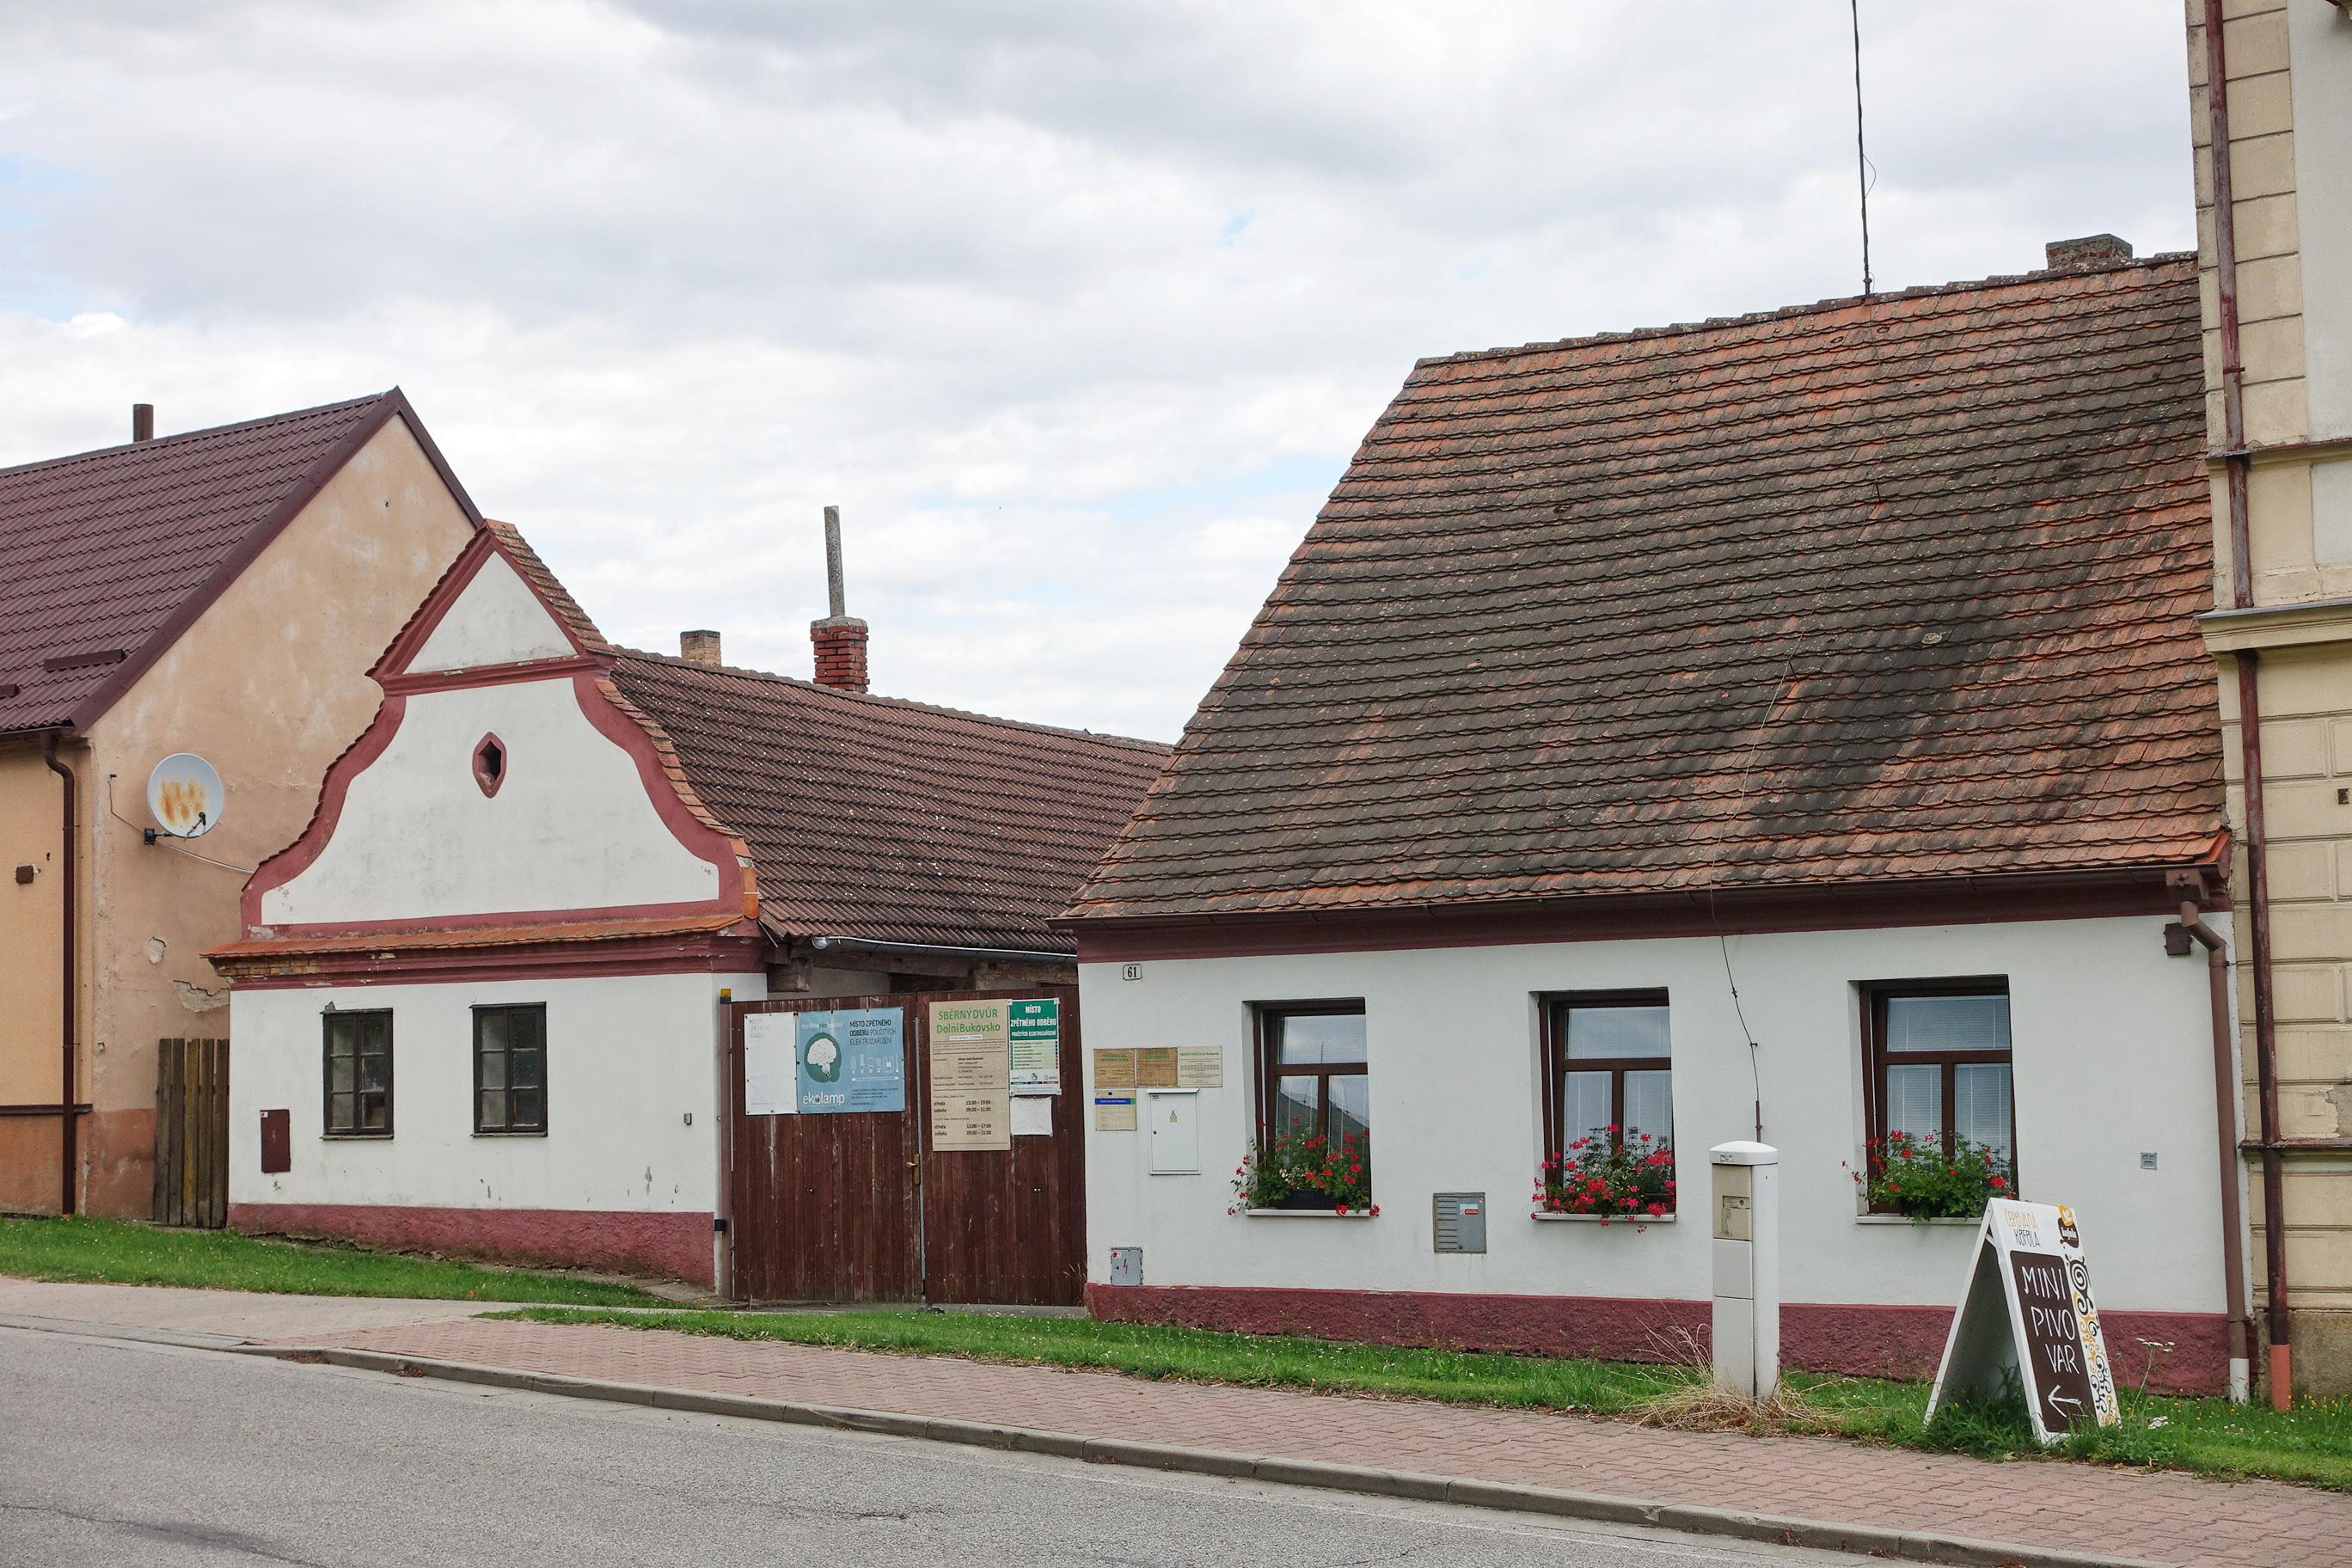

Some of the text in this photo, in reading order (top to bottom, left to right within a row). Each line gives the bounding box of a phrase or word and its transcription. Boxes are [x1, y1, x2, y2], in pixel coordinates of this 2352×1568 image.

[1127, 966, 1136, 978] 61
[938, 1006, 998, 1020] SBĚRNÝ DVŮR
[1025, 1004, 1042, 1014] MÍSTO
[866, 1019, 891, 1027] ZPĚTNÉHO
[936, 1022, 1001, 1033] Dolní Bukovsko
[802, 1091, 845, 1106] ekolamp
[2021, 1265, 2067, 1301] MINI
[2030, 1305, 2076, 1341] PIVO
[2045, 1344, 2080, 1375] VAR
